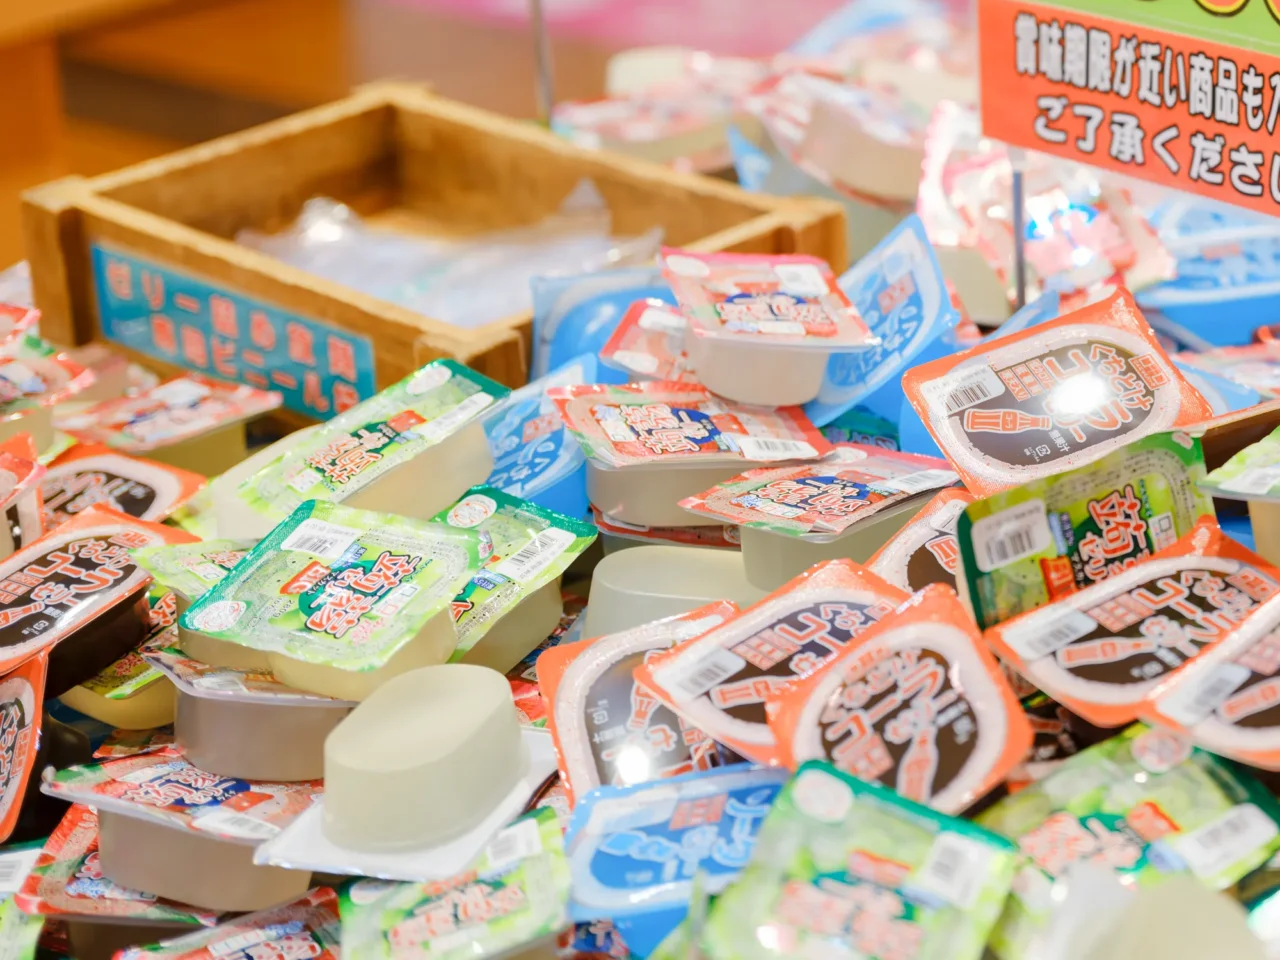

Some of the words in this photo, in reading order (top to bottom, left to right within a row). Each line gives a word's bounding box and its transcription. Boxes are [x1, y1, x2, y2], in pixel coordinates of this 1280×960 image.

[1046, 348, 1134, 431] コラ
[1090, 344, 1153, 411] くちどけ
[24, 552, 124, 592] コーラ
